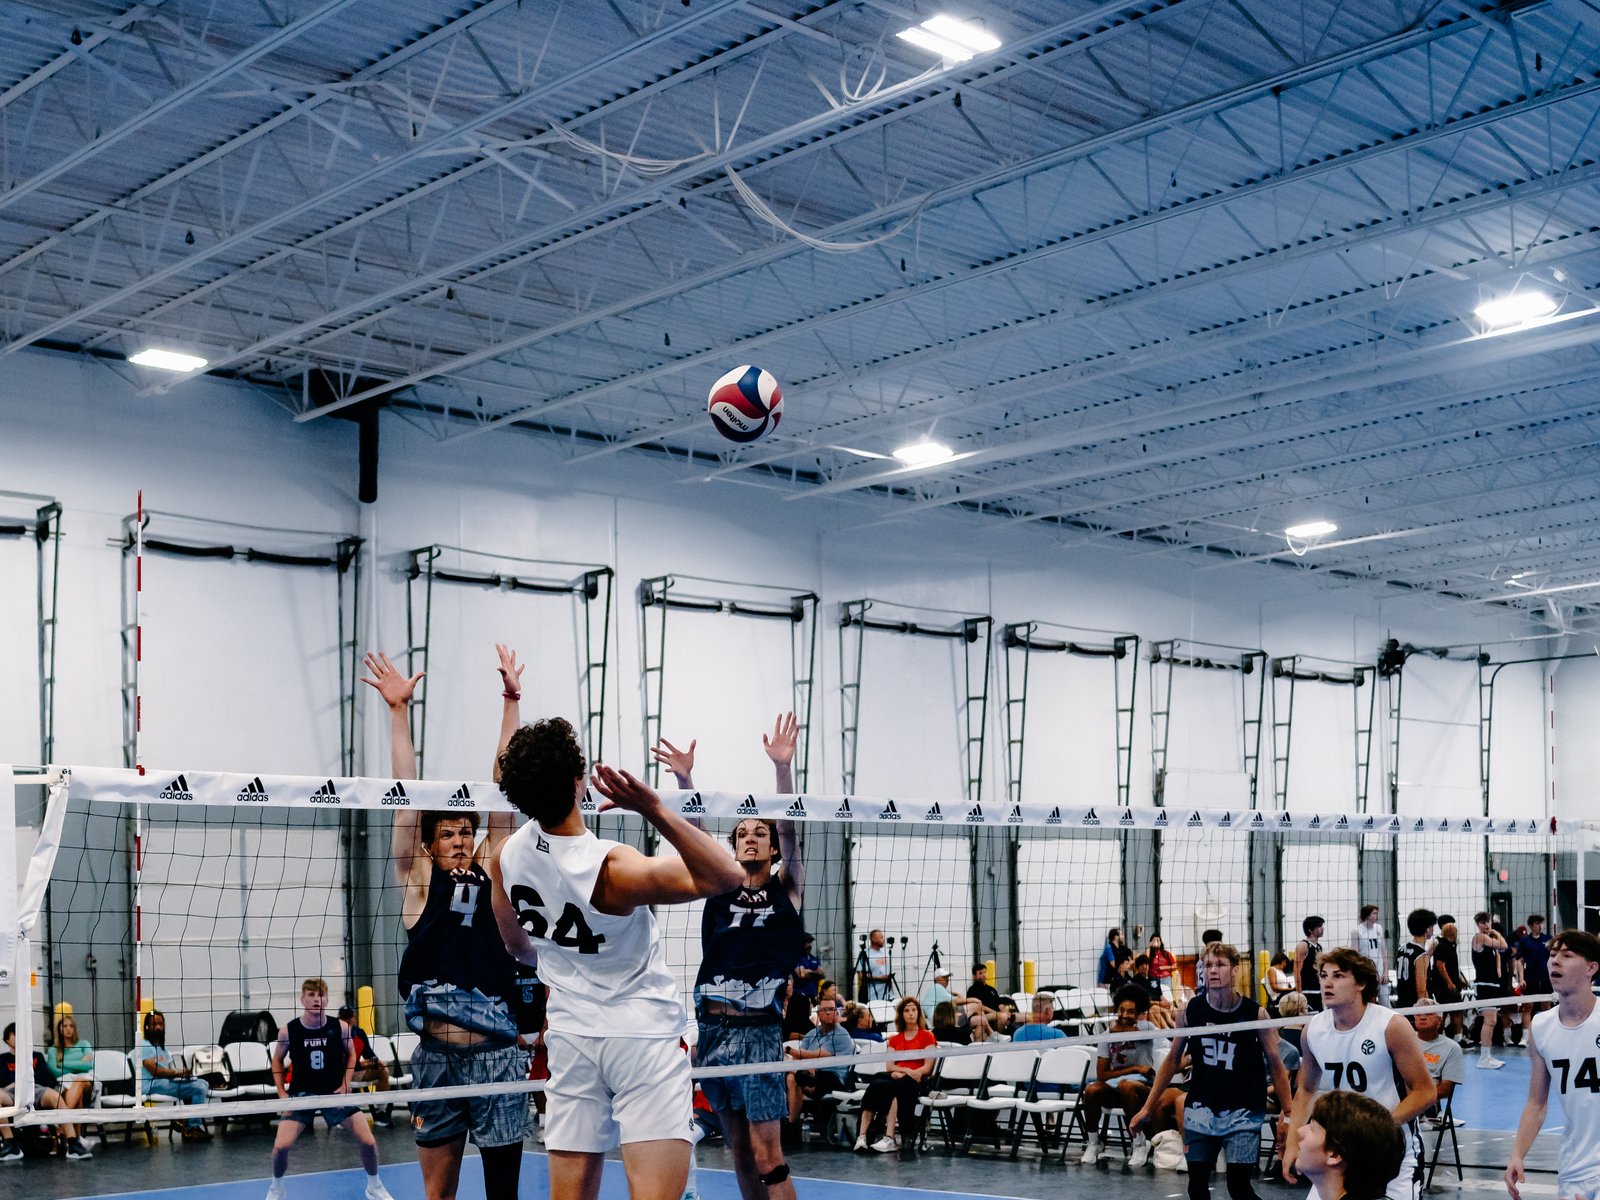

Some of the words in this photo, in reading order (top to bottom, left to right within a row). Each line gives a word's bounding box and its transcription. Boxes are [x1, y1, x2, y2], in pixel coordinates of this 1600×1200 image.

[722, 405, 749, 431] molten
[159, 790, 193, 801] adidas
[236, 792, 269, 802] adidas
[309, 794, 341, 804] adidas
[381, 796, 410, 806] adidas
[447, 797, 475, 808] adidas
[681, 805, 706, 814] adidas
[736, 806, 759, 815] adidas
[785, 809, 807, 818] adidas
[449, 882, 481, 928] 4
[510, 884, 606, 955] 64
[1368, 938, 1378, 949] 11
[1201, 1037, 1237, 1071] 34
[310, 1050, 325, 1070] 8
[1324, 1061, 1368, 1093] 70
[1551, 1057, 1600, 1095] 74
